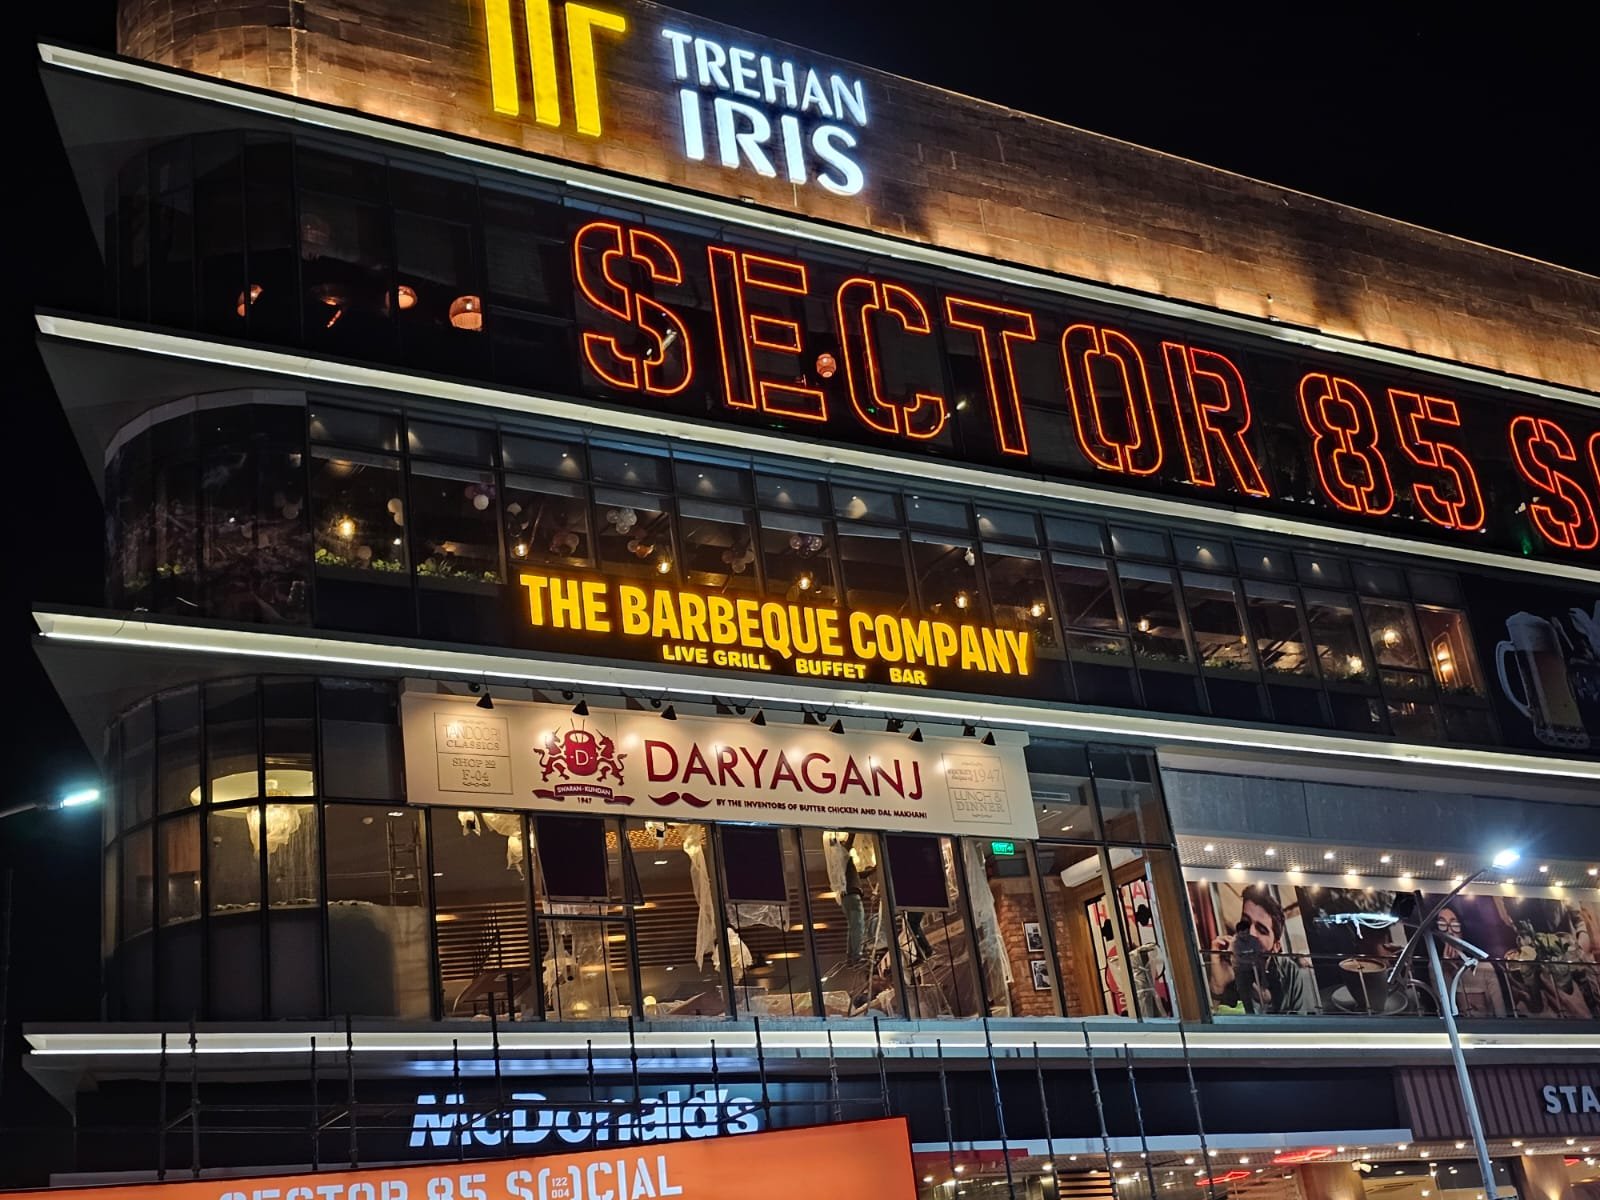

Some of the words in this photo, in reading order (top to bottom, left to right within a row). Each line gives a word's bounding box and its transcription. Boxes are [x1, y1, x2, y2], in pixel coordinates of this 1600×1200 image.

[662, 29, 867, 127] TREHAN
[680, 89, 864, 196] IRIS
[573, 220, 1271, 498] SECTOR
[1299, 372, 1486, 531] 85
[1510, 415, 1600, 549] S
[520, 574, 610, 632] THE
[619, 585, 843, 659] BARBEQUE
[849, 611, 1029, 676] COMPANY
[662, 644, 708, 664] LIVE
[713, 650, 771, 670] GRILL
[796, 658, 866, 679] BUFFET
[889, 667, 927, 686] BAR
[446, 739, 500, 751] CLASSICS
[452, 757, 482, 768] SHOP
[574, 750, 590, 766] D
[645, 740, 923, 801] DARYAGANJ
[974, 768, 1000, 783] 1947
[953, 790, 992, 802] LUNCH
[955, 801, 1005, 813] DINNER
[727, 799, 742, 807] THE
[744, 800, 786, 810] INVENTORS
[799, 804, 826, 813] BUTTER
[827, 806, 859, 814] CHICKEN
[860, 807, 876, 815] AND
[893, 810, 928, 819] MAKHANI
[1543, 1085, 1600, 1114] STA
[409, 1088, 760, 1147] McDonald's
[506, 1155, 683, 1200] SOCIAL
[552, 1176, 568, 1187] 122
[552, 1189, 569, 1199] 004
